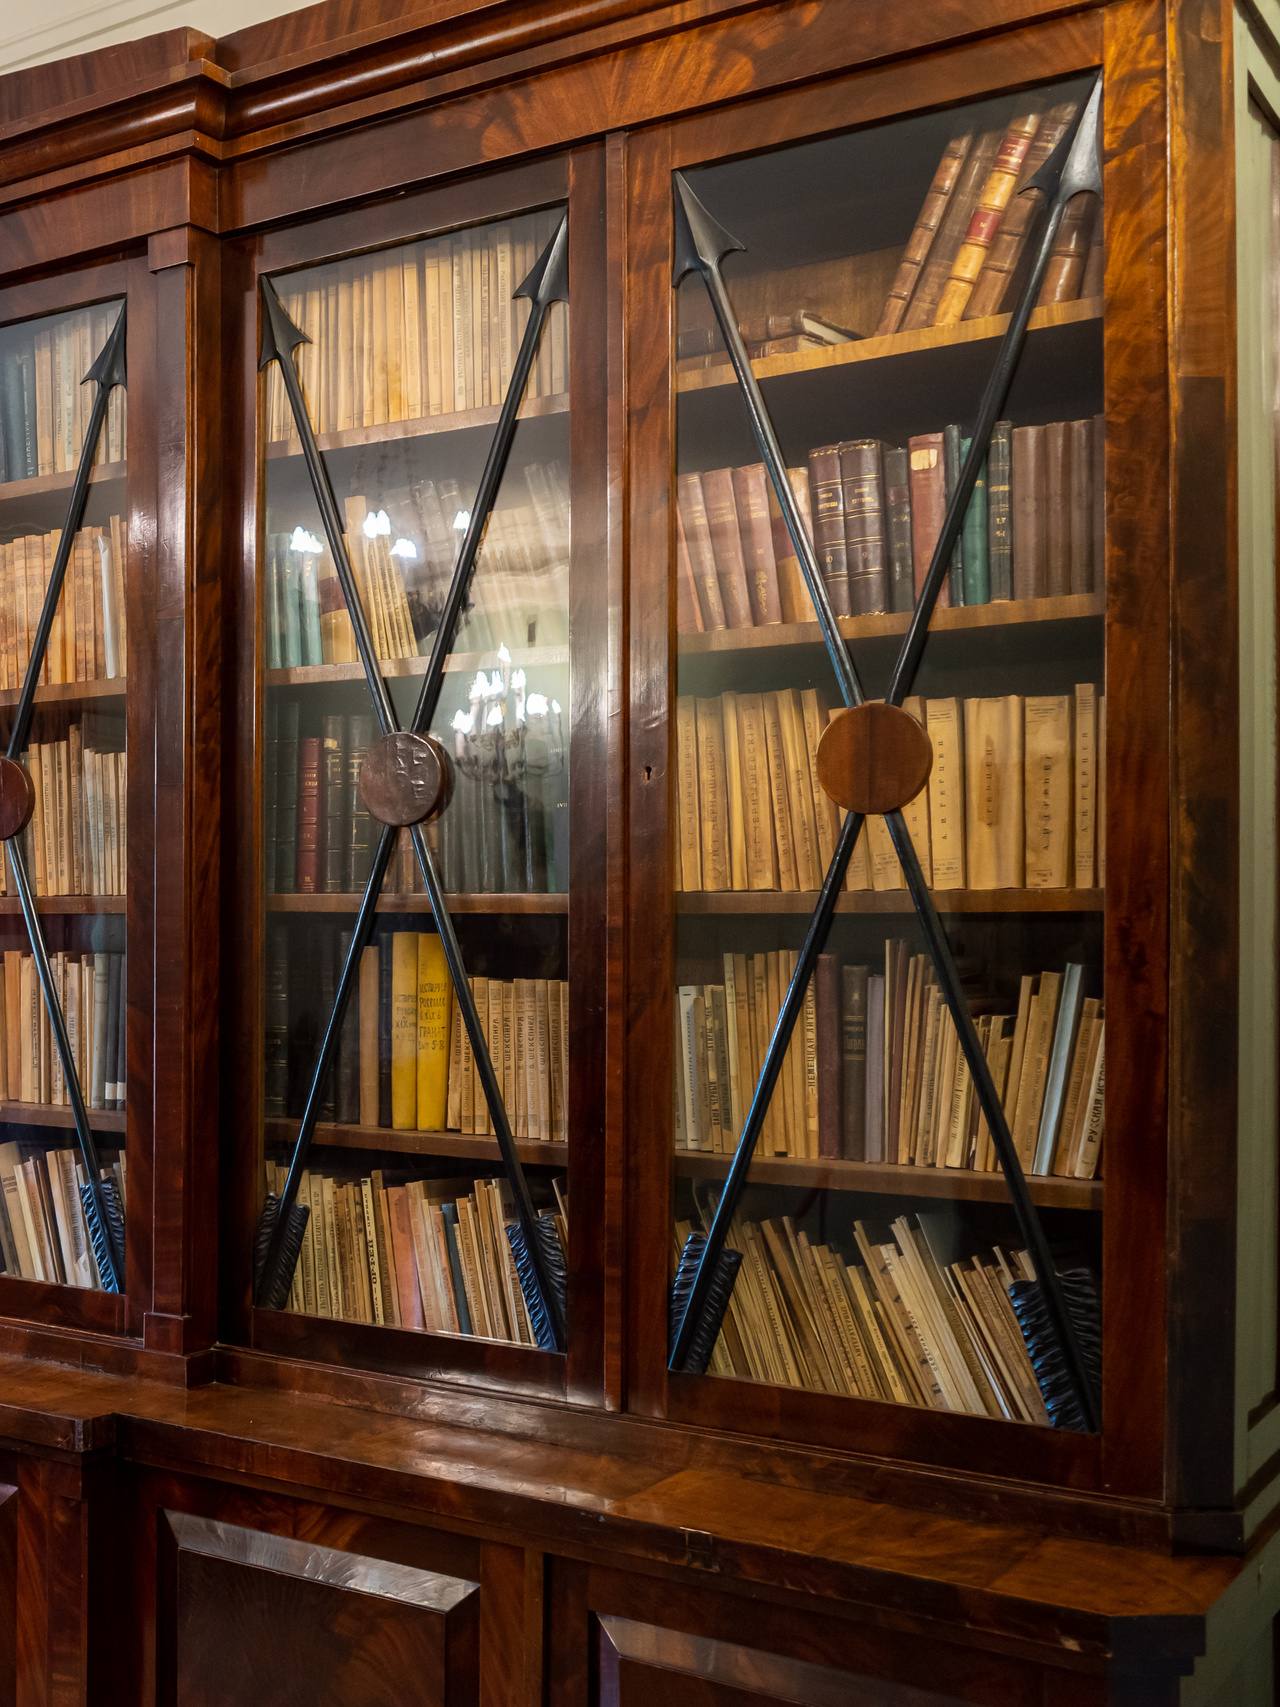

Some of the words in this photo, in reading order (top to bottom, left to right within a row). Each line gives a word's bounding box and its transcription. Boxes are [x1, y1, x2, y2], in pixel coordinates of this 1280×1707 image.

[825, 554, 833, 564] 10
[862, 551, 868, 559] 9
[419, 982, 447, 994] ИСТОРИЯ
[419, 997, 447, 1009] РОССИИ
[419, 1026, 446, 1038] ГРАНАТ
[492, 1017, 500, 1063] ШЕКСПИРА
[503, 1017, 511, 1062] ШЕКСПИРА
[517, 1016, 525, 1061] ШЕКСПИРА
[806, 1037, 816, 1087] НЕМЕЦКАЯ
[1087, 1099, 1103, 1143] РУССКАЯ
[368, 1238, 378, 1285] ОРФЕЙ
[907, 1309, 919, 1330] АЗИЯ
[917, 1333, 938, 1372] СЕВЕРНАЯ
